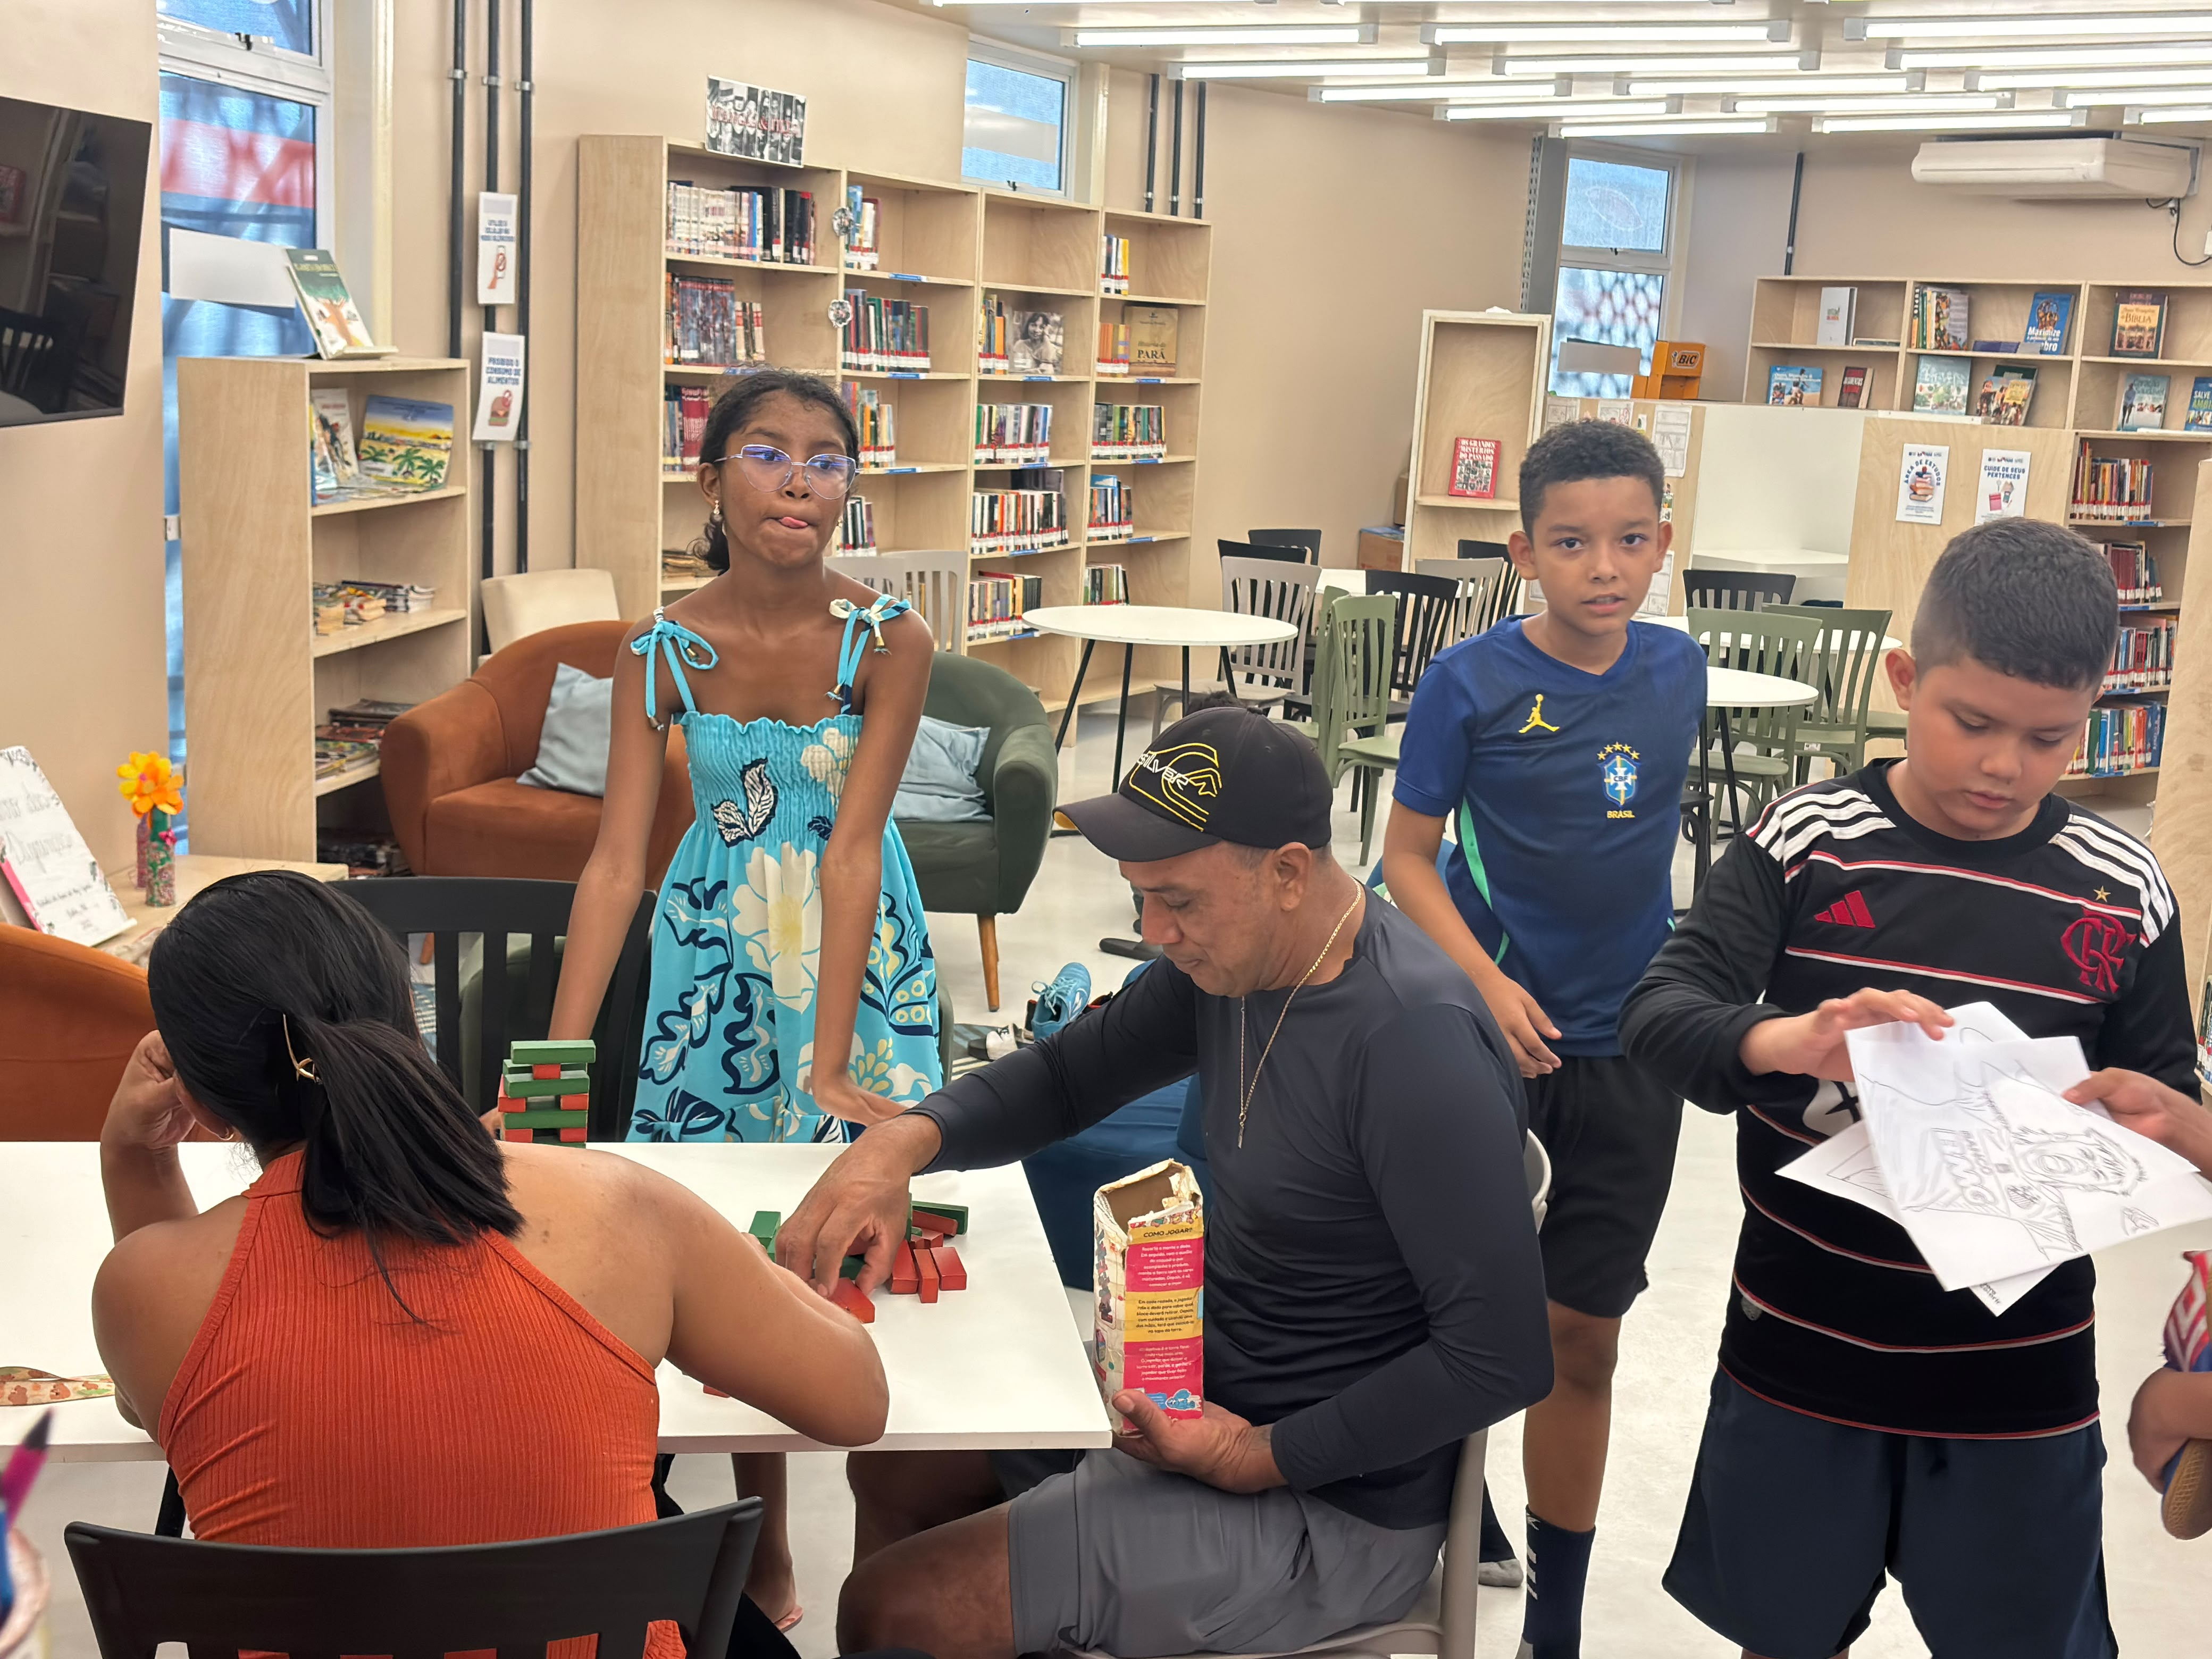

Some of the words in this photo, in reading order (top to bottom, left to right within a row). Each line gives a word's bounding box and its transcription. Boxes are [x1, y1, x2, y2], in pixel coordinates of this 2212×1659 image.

[2027, 326, 2061, 337] Maximize
[1138, 348, 1166, 359] PARÁ
[1679, 354, 1697, 364] BIC
[1925, 459, 1941, 486] ESTUDOS
[1607, 810, 1635, 819] BRASIL
